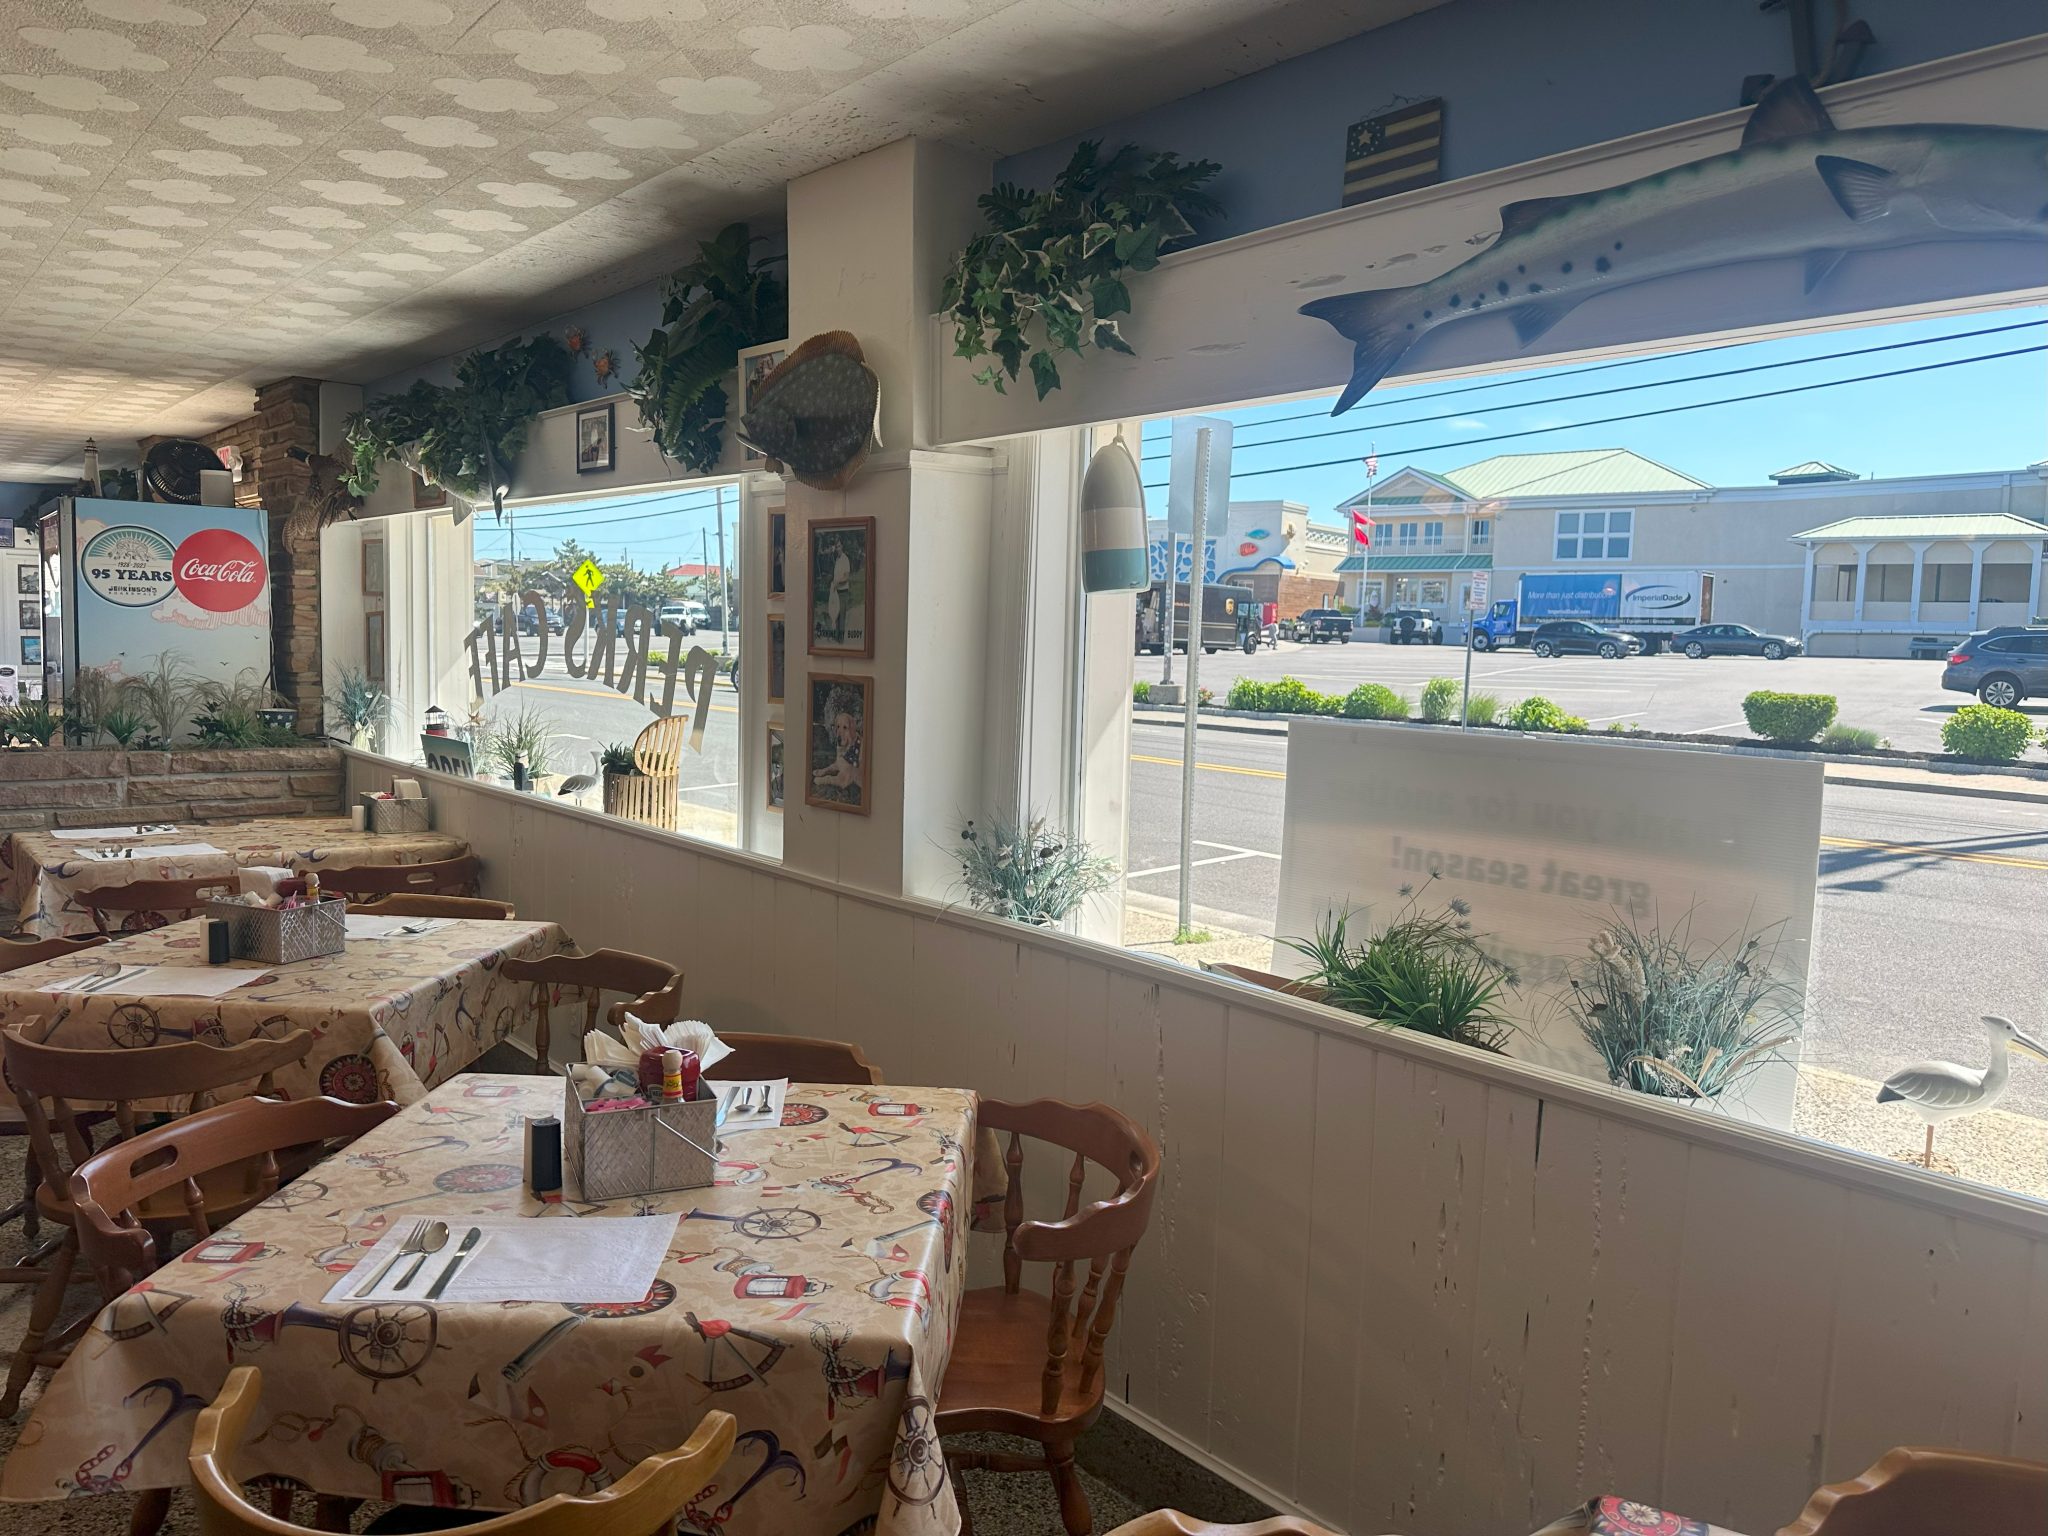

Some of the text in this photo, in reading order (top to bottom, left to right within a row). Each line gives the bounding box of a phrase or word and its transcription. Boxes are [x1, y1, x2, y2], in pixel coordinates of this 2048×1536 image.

[91, 568, 173, 582] 95 YEARS
[180, 558, 260, 583] Coca-Cola
[1546, 591, 1561, 600] than
[1561, 591, 1574, 601] just
[1632, 594, 1683, 602] ImperialDade
